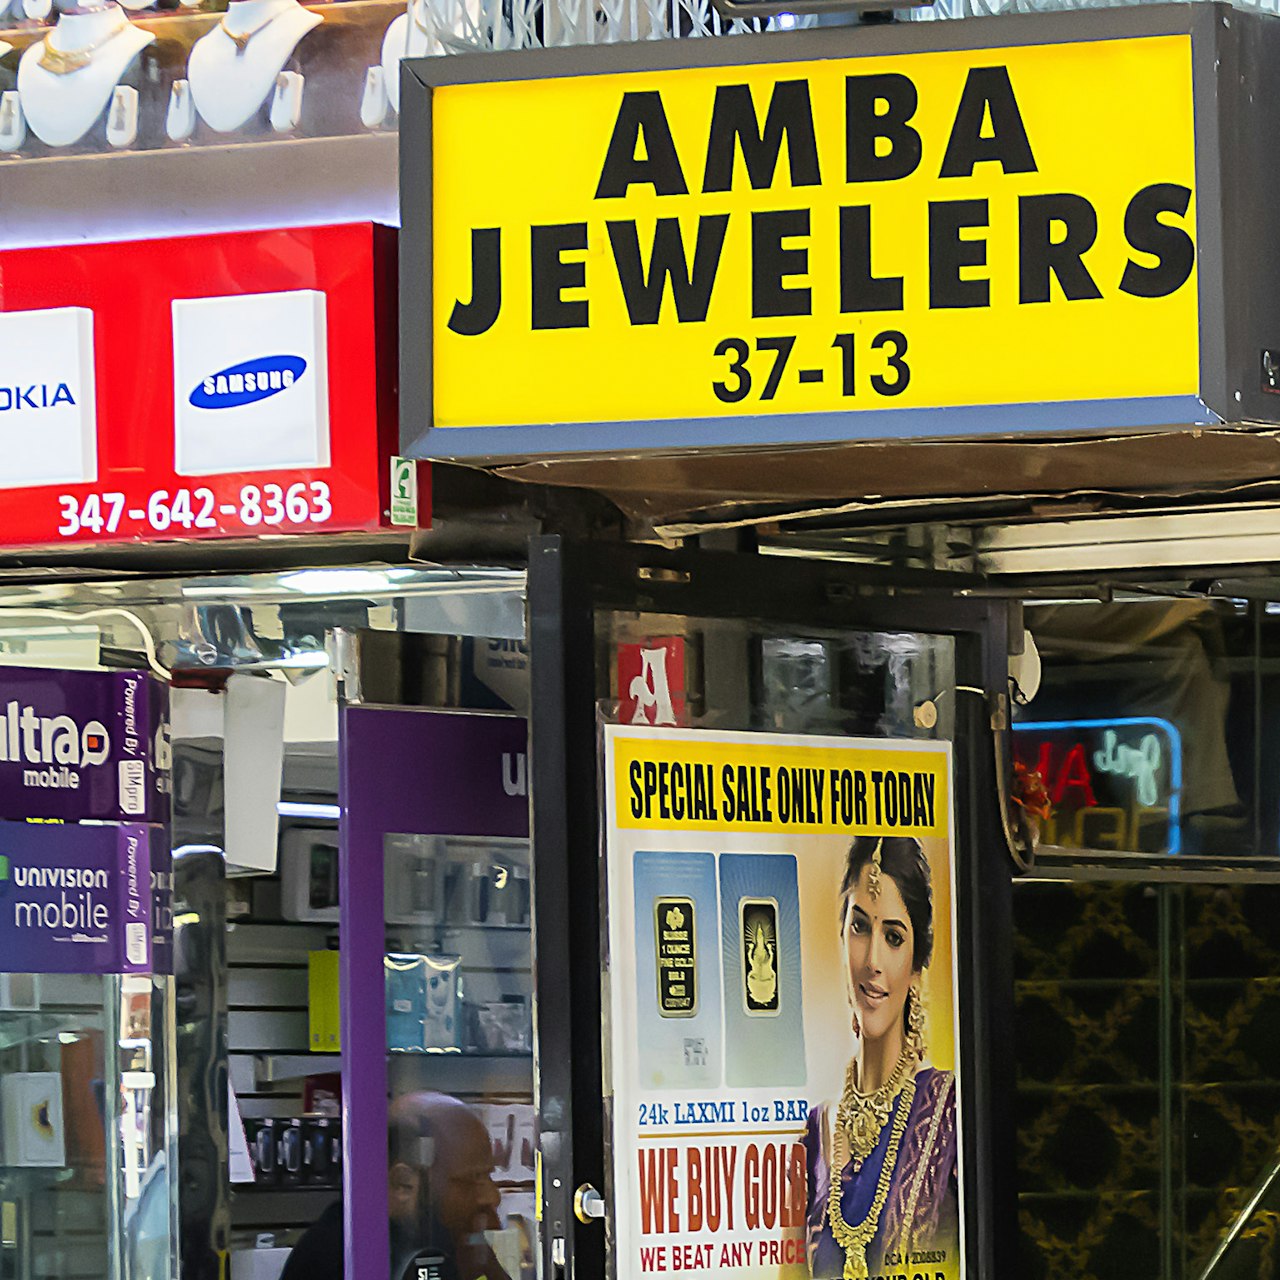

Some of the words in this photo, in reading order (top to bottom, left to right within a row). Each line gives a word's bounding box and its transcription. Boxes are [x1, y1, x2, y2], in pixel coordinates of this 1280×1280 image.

[594, 65, 1039, 200] AMBA
[447, 183, 1196, 336] JEWELERS
[203, 370, 294, 397] SAMSUNG
[711, 331, 911, 403] 37-13
[58, 481, 332, 536] 347-642-8363
[23, 767, 80, 789] mobile
[629, 760, 718, 821] SPECIAL
[722, 763, 773, 823] SALE
[777, 766, 825, 824] ONLY
[830, 769, 868, 826] FOR
[871, 770, 937, 828] TODAY
[14, 866, 109, 890] univision
[15, 891, 110, 929] mobile
[638, 1103, 669, 1127] 24k
[674, 1102, 736, 1126] LAXMI
[775, 1099, 810, 1123] BAR
[638, 1146, 680, 1236] WE
[687, 1144, 738, 1234] BUY
[743, 1142, 809, 1232] GOLD
[640, 1245, 668, 1273] WE
[672, 1243, 717, 1271] BEAT
[719, 1242, 754, 1269] ANY
[758, 1239, 807, 1266] PRICE
